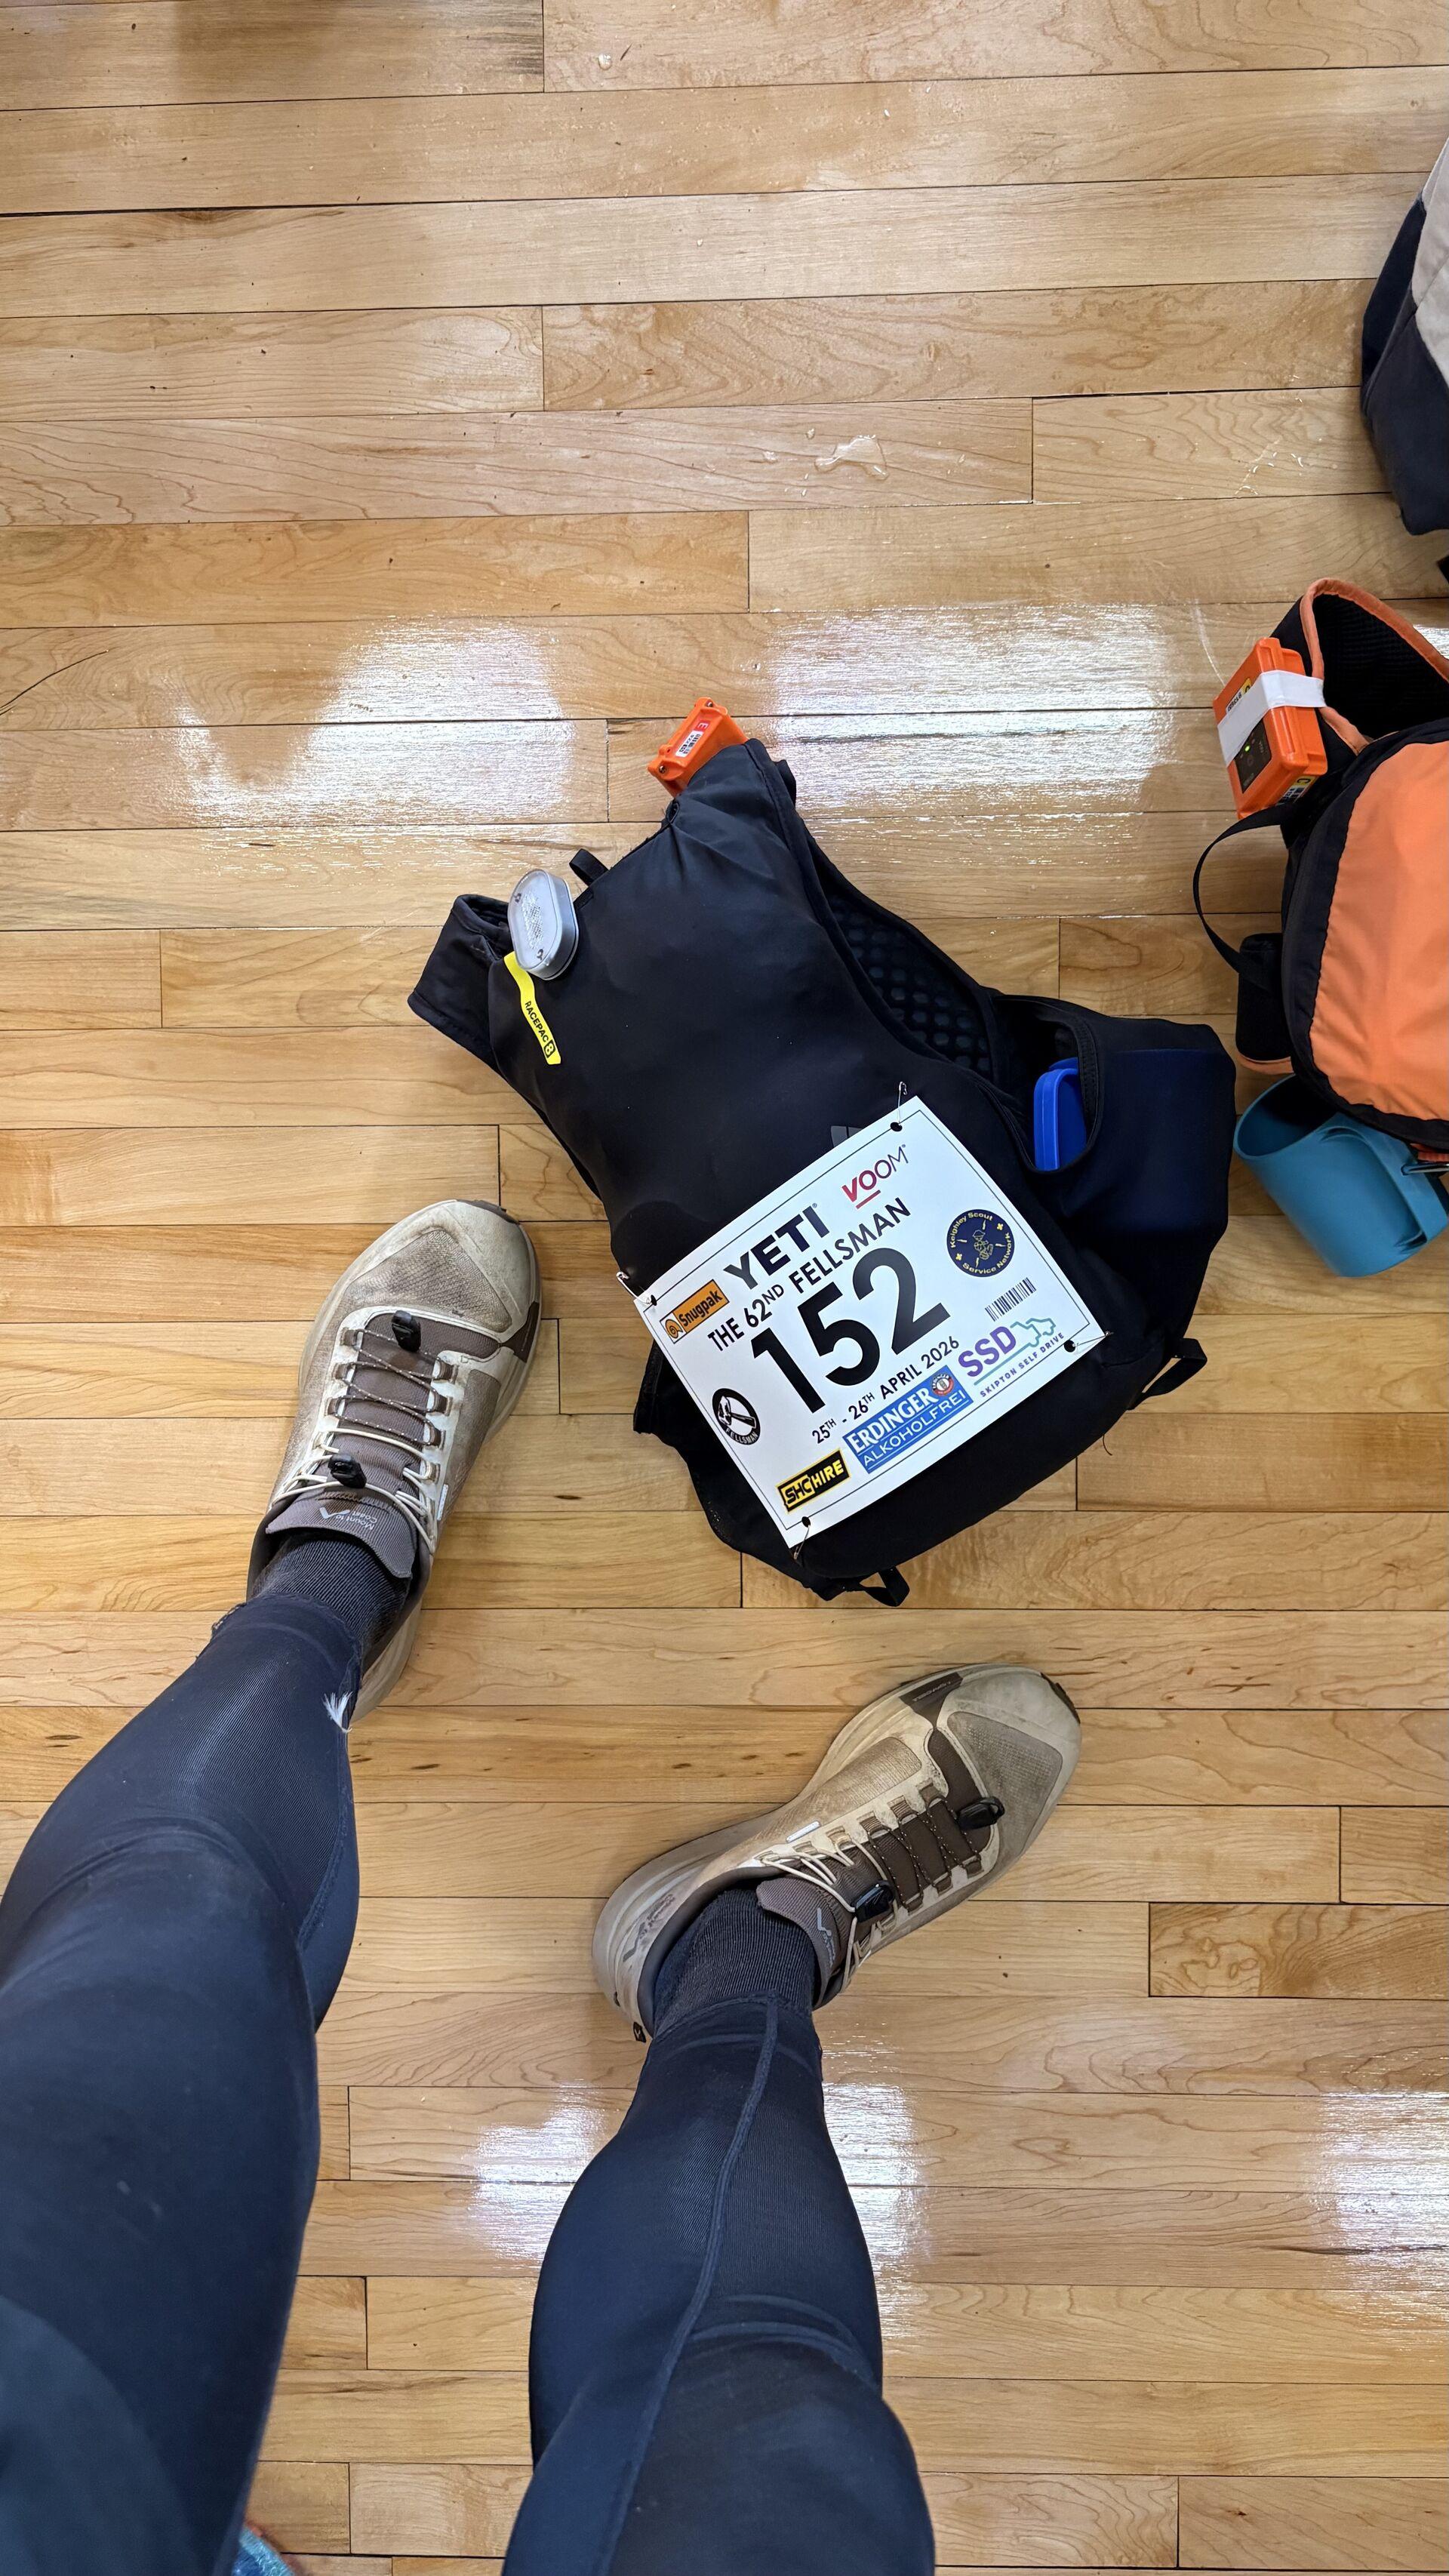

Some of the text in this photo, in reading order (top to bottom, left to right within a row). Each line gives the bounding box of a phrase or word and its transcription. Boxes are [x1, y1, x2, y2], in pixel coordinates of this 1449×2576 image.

[525, 1000, 549, 1042] RACEPAC
[841, 1146, 909, 1202] VOOM
[723, 1205, 830, 1290] YETI
[949, 1212, 993, 1248] Keighley Scout
[962, 1233, 1012, 1274] Service Network
[707, 1197, 911, 1351] THE 62ND FELLSMAN
[678, 1290, 723, 1327] Snugpak
[751, 1248, 951, 1414] 152
[958, 1326, 1017, 1377] SSD
[980, 1332, 1065, 1397] SKIPTON SELF DRIVE
[812, 1418, 837, 1444] 25TH
[848, 1392, 875, 1420] 26TH
[880, 1364, 922, 1400] APRIL
[921, 1335, 959, 1369] 2026
[725, 1427, 758, 1444] FELLSMAN
[846, 1387, 940, 1453] ERDINGER
[863, 1390, 966, 1467] ALKOHOLFREI
[811, 1459, 844, 1488] HIRE
[346, 1516, 375, 1530] Mount
